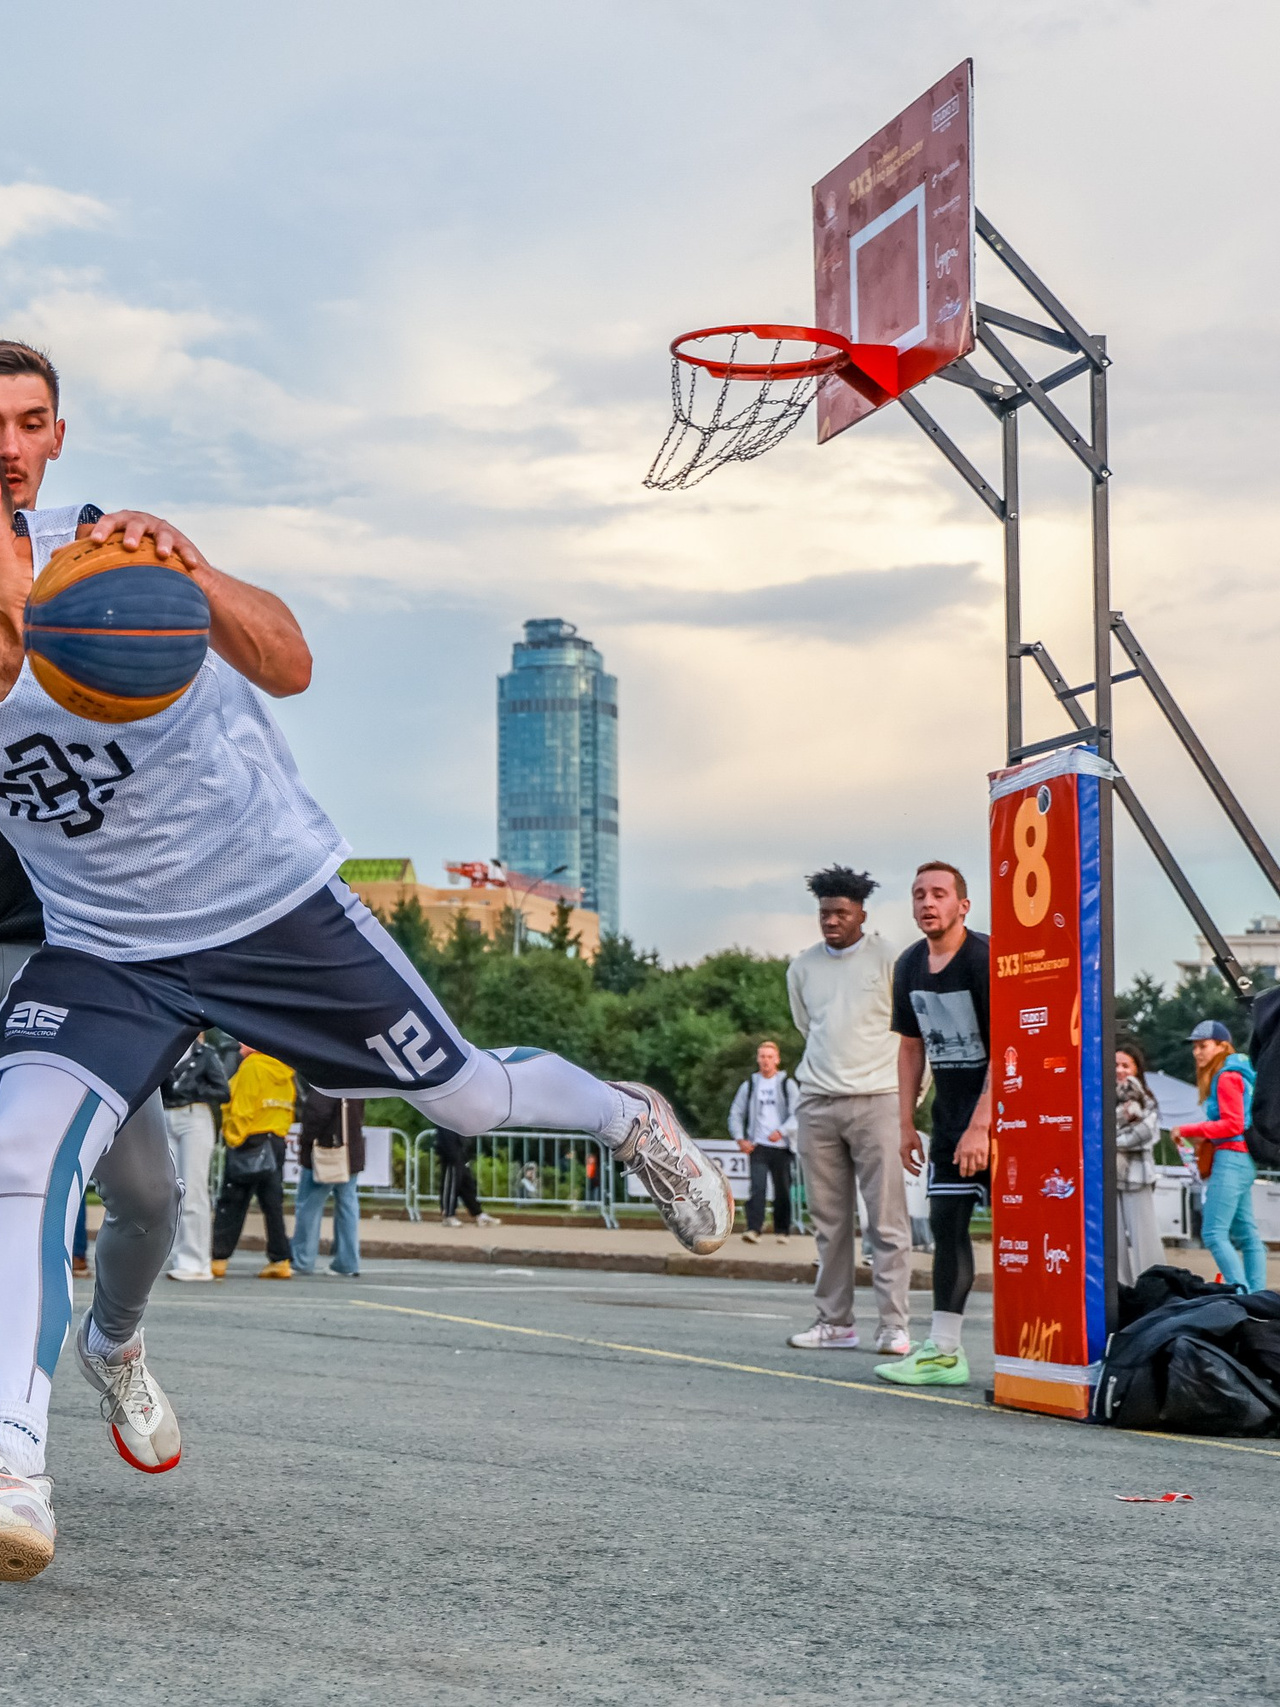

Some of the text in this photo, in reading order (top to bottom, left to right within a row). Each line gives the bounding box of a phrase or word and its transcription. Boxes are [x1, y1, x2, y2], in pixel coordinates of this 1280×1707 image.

[1012, 796, 1052, 928] 8
[996, 953, 1020, 979] 3X3
[364, 1009, 448, 1082] 12
